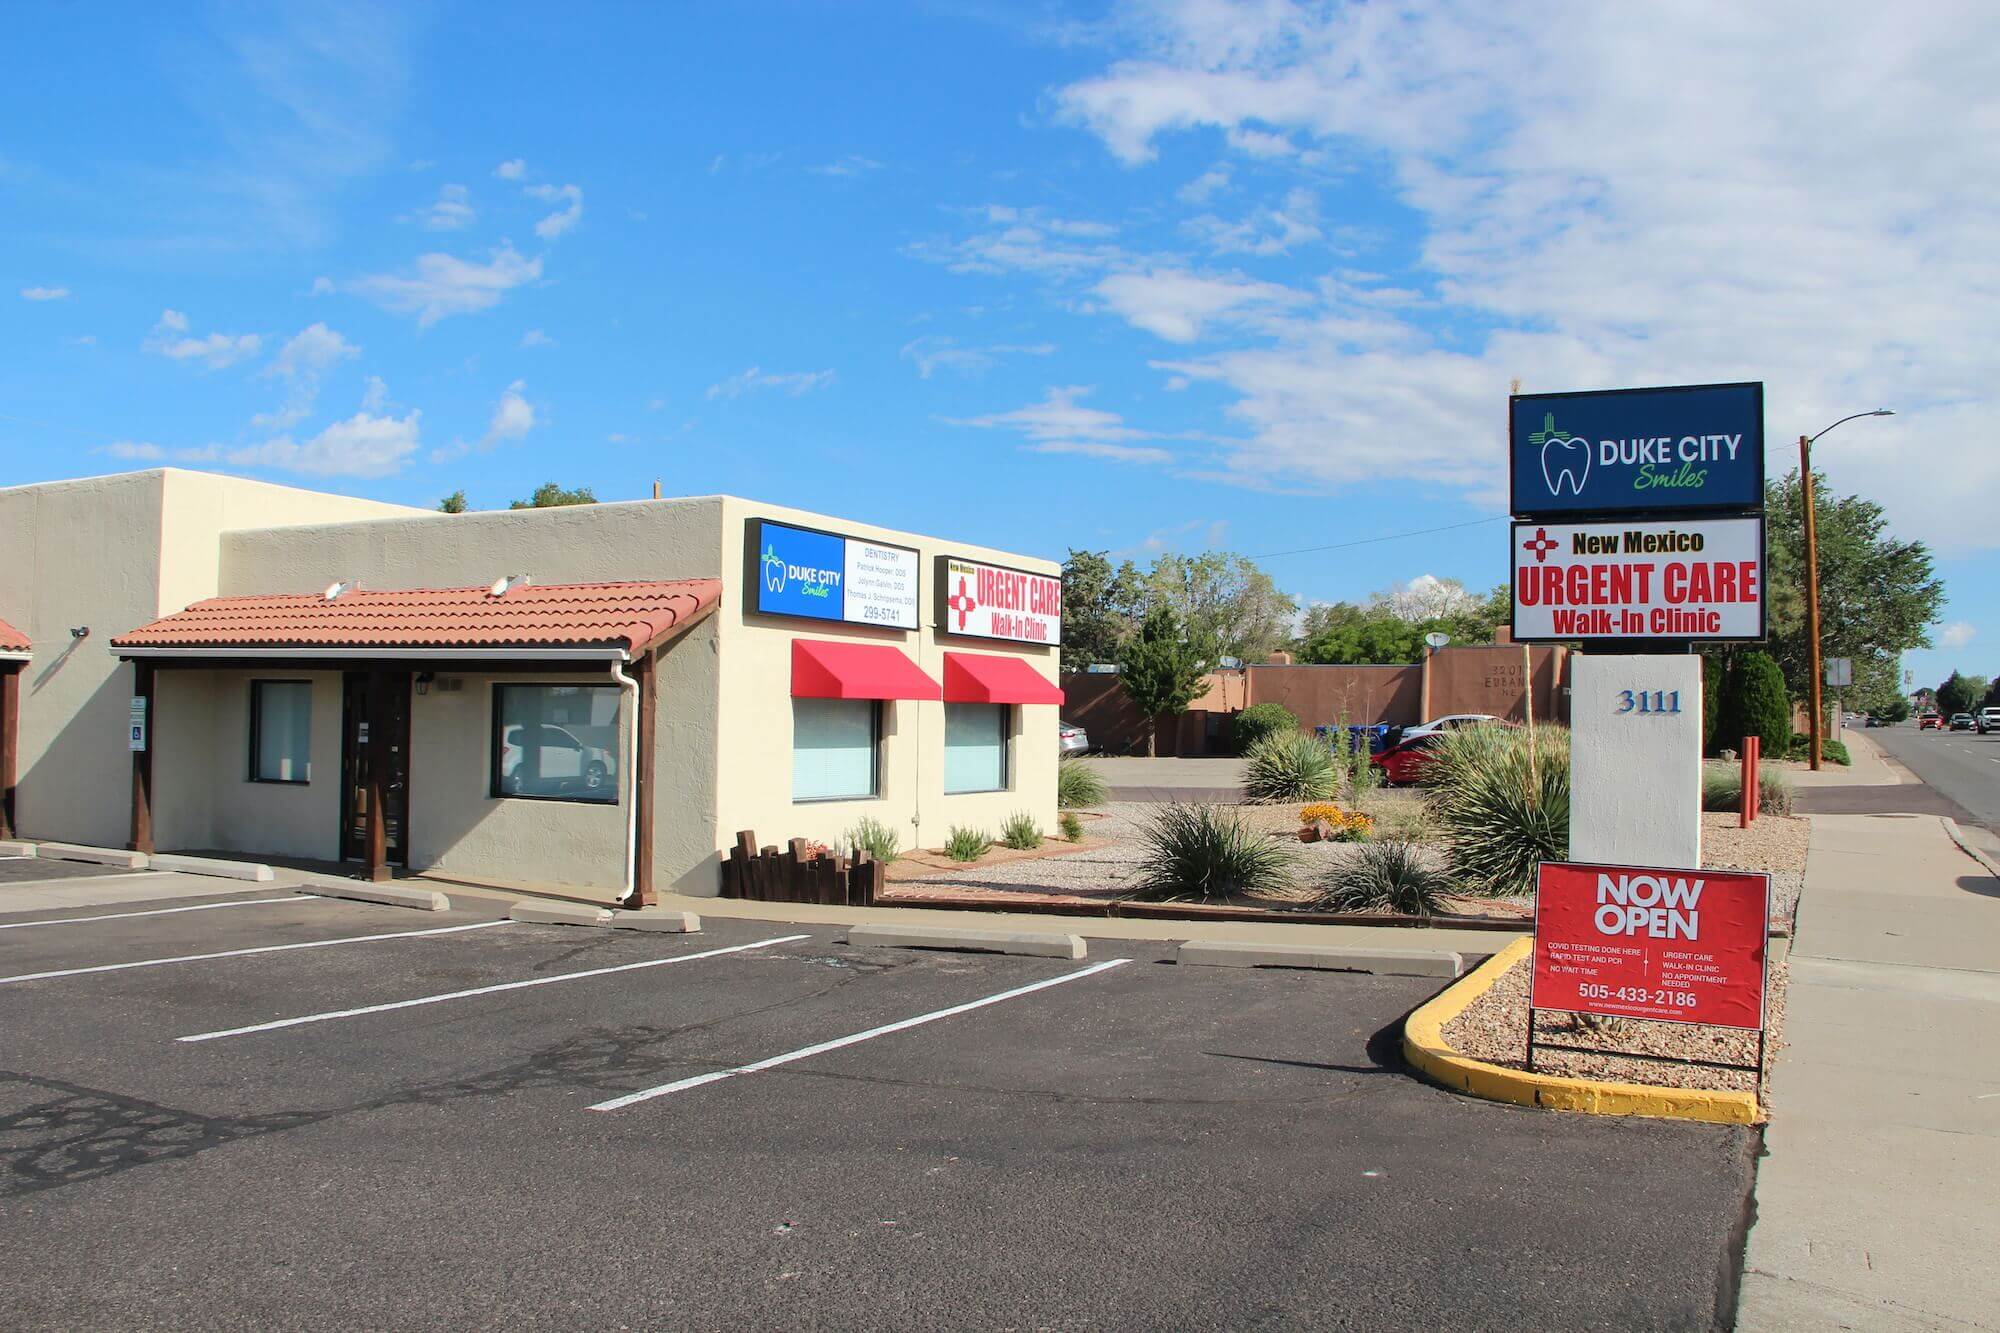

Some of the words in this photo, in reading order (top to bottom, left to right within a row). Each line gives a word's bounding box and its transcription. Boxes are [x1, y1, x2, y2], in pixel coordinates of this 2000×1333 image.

[1600, 437, 1671, 465] DUKE
[1678, 434, 1742, 462] CITY
[1634, 462, 1708, 490] Smiles
[1573, 532, 1619, 554] New
[1623, 530, 1704, 553] Mexico
[865, 548, 900, 562] DENTISTRY
[789, 565, 817, 583] DUKE
[818, 570, 841, 586] CITY
[1518, 564, 1654, 606] URGENT
[1664, 561, 1757, 604] CARE
[802, 582, 829, 598] Smiles
[977, 567, 1027, 612] URGENT
[1030, 577, 1060, 616] CARE
[864, 606, 900, 621] 299-5741
[1553, 609, 1644, 634] Walk-In
[1650, 607, 1720, 633] Clinic
[992, 612, 1023, 638] Walk-In
[1025, 616, 1047, 640] Clinic
[1618, 689, 1682, 713] 3111
[1596, 873, 1705, 910] NOW
[1594, 904, 1699, 941] OPEN
[1548, 942, 1570, 950] COVID
[1571, 943, 1600, 953] TESTING
[1601, 946, 1621, 954] DONE
[1622, 948, 1641, 956] HERE
[1550, 952, 1572, 960] RAPID
[1573, 954, 1590, 962] TEST
[1608, 957, 1623, 965] PCR
[1663, 952, 1694, 960] URGENT
[1694, 954, 1714, 962] CARE
[1562, 966, 1578, 974] WAIT
[1580, 968, 1599, 976] TIME
[1662, 962, 1694, 971] WALK-IN
[1695, 964, 1720, 973] CLINIC
[1674, 973, 1728, 984] APPOINTMENT
[1579, 983, 1697, 1007] 505-433-2186
[1661, 980, 1690, 988] NEEDED
